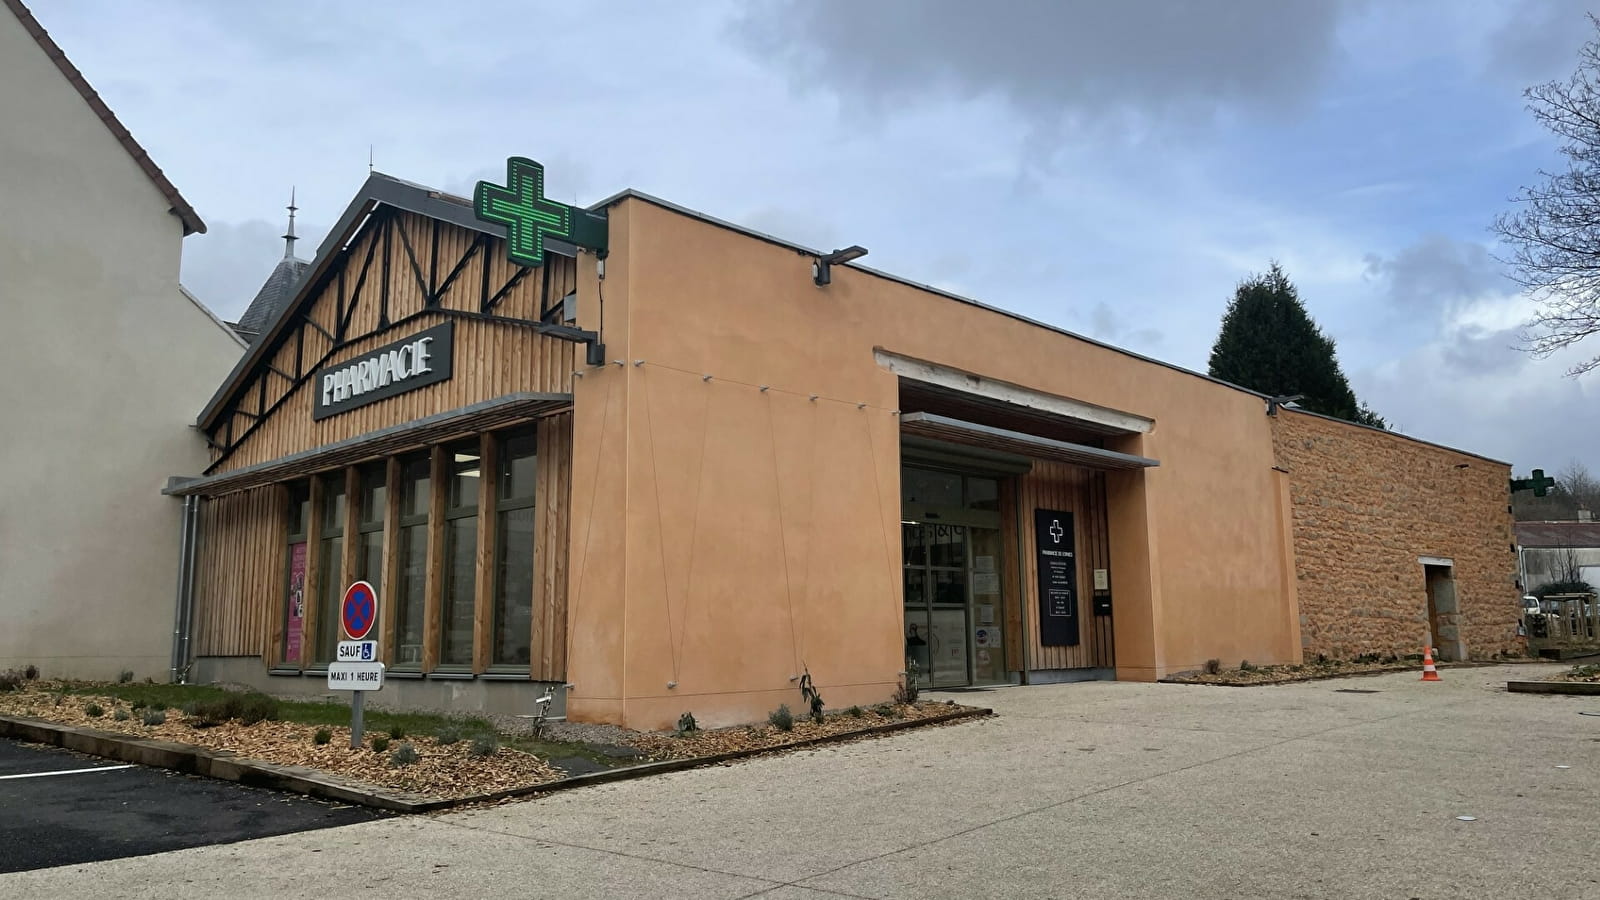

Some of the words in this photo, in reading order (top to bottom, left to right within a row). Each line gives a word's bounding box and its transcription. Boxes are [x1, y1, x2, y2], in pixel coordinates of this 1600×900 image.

[322, 336, 433, 406] PHARMACIE
[340, 645, 360, 657] SAUF
[331, 672, 347, 681] MAXI
[350, 672, 354, 681] 1
[357, 672, 378, 681] HEURE
